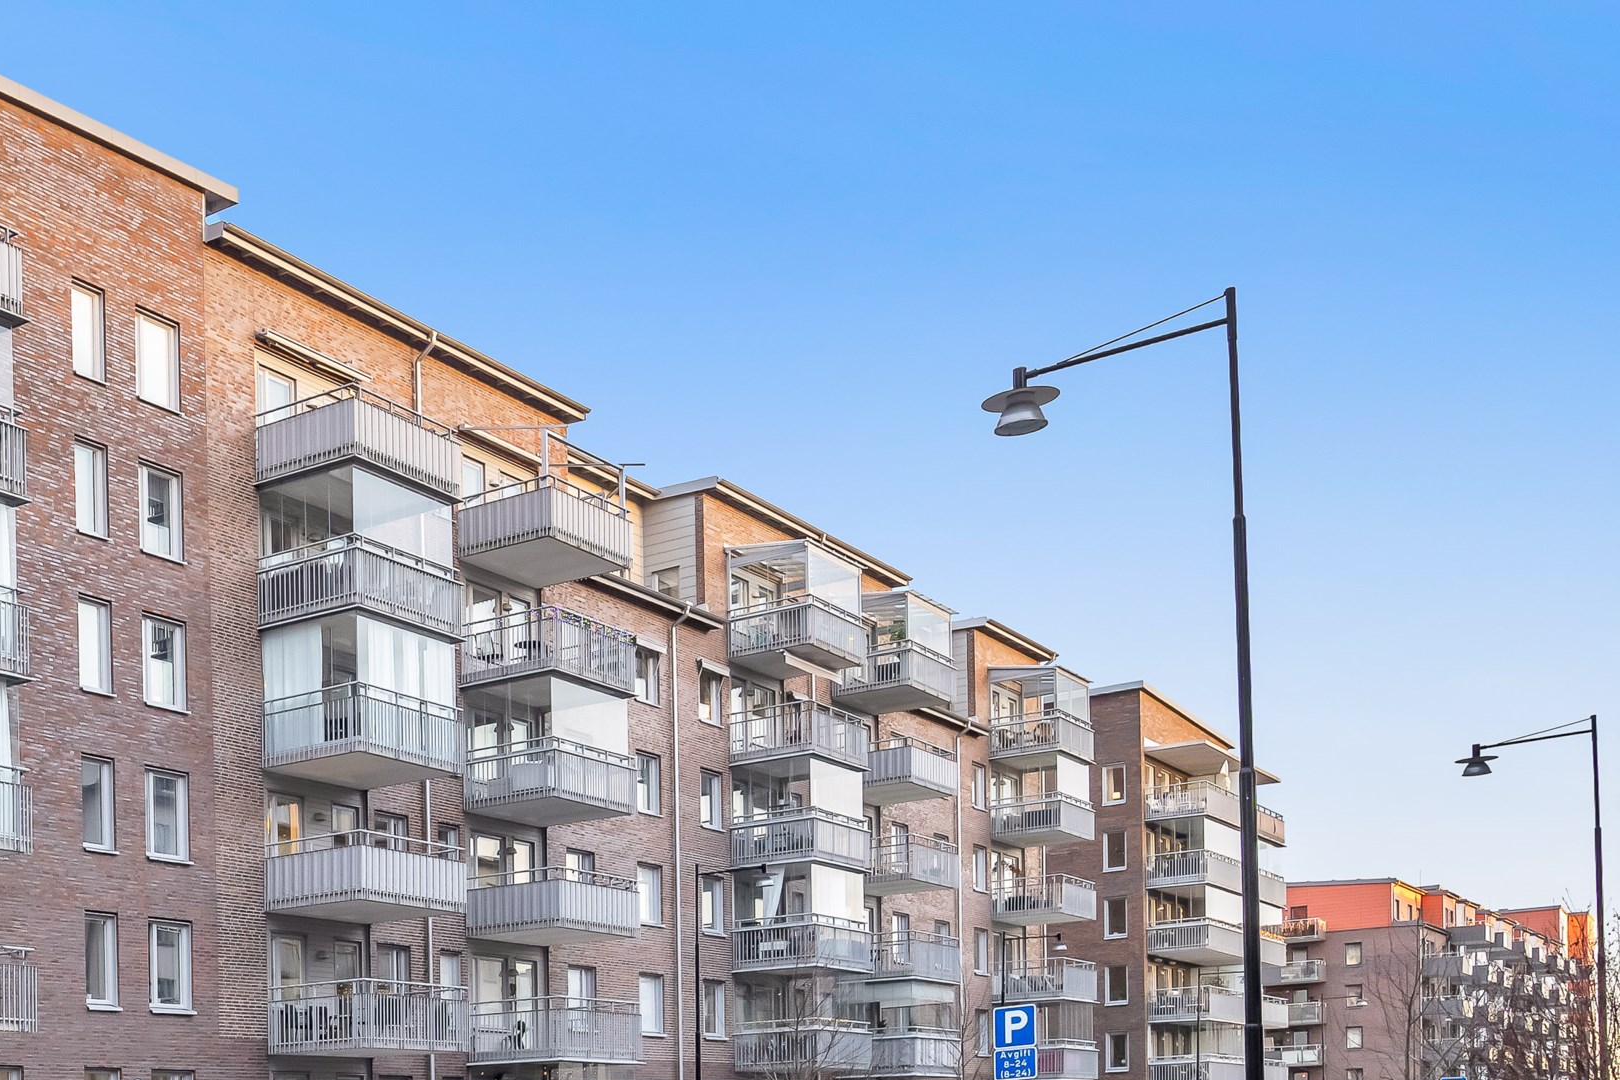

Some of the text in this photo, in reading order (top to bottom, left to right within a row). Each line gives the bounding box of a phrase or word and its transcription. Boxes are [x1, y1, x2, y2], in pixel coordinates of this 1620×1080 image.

[1004, 1010, 1028, 1044] P
[1000, 1050, 1031, 1060] Avgift
[1004, 1060, 1027, 1068] 8-24
[1000, 1068, 1031, 1079] (8-24)
